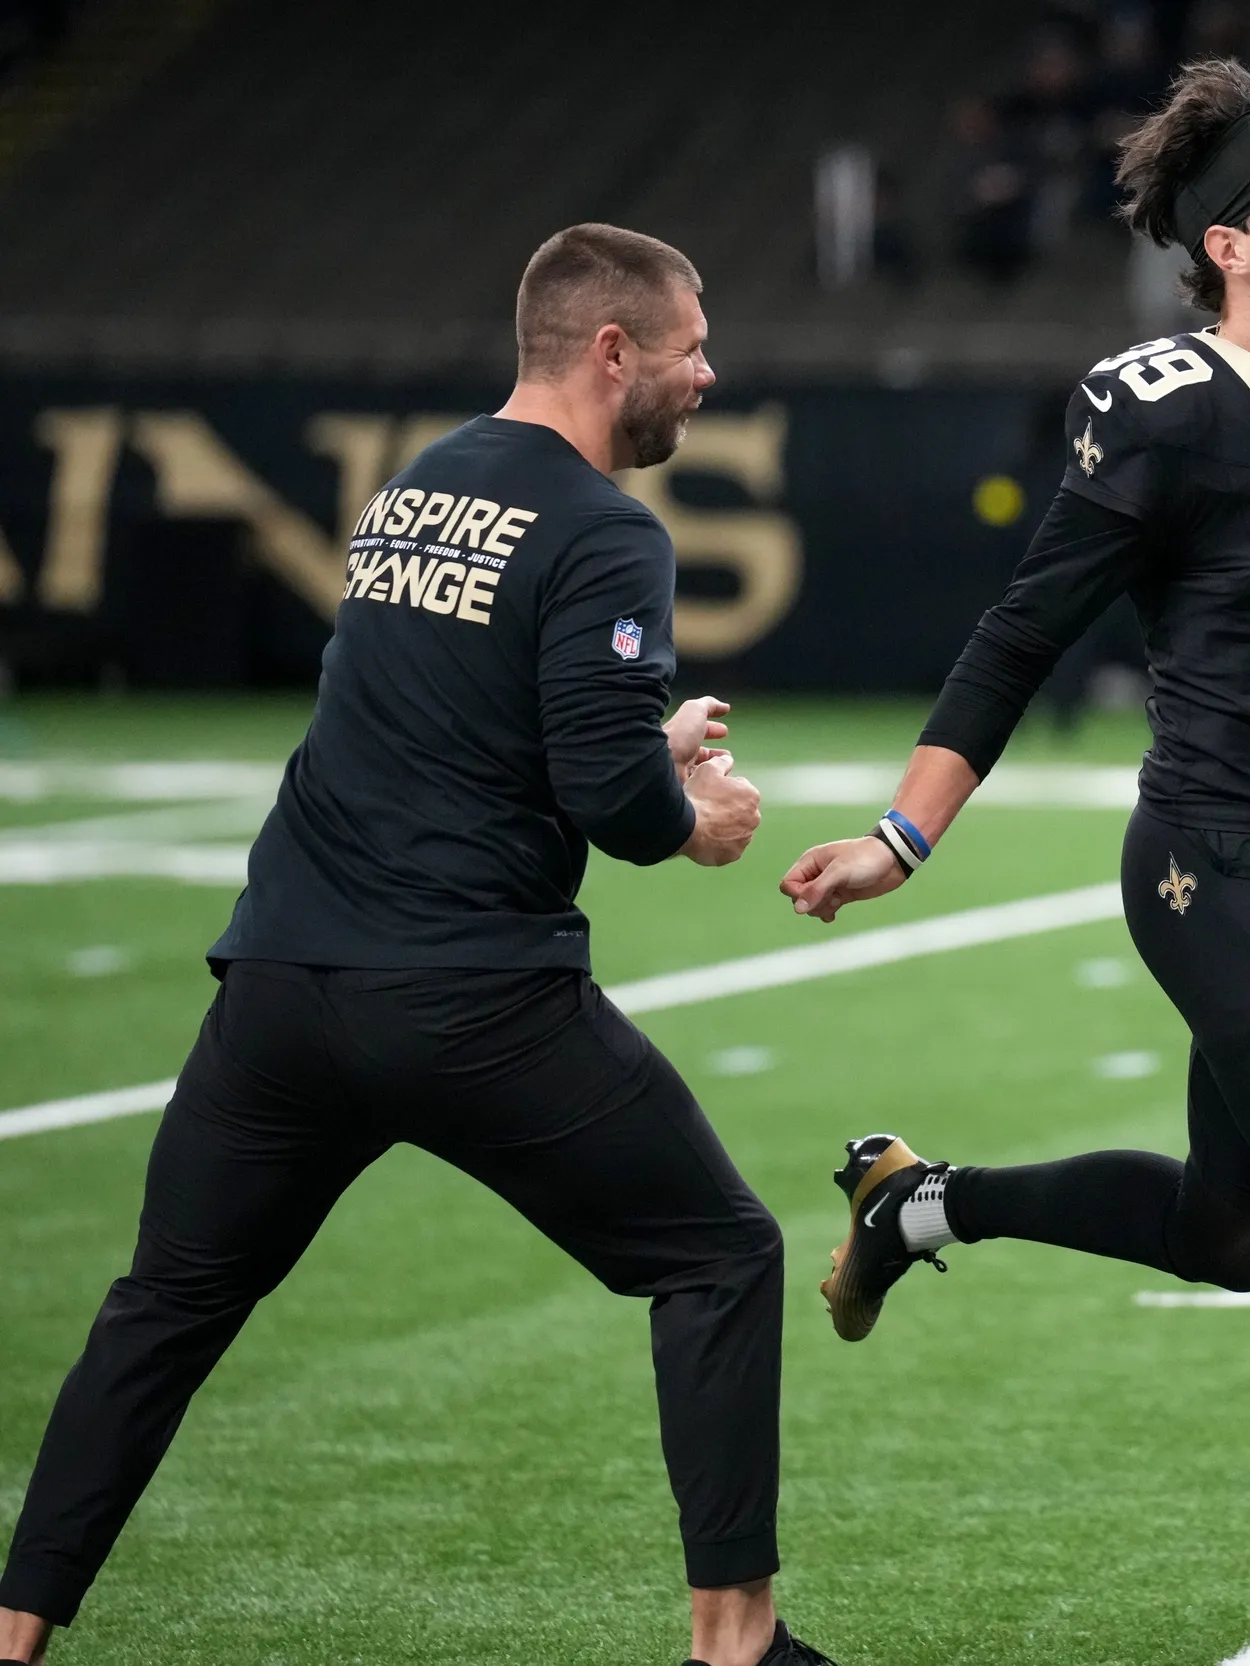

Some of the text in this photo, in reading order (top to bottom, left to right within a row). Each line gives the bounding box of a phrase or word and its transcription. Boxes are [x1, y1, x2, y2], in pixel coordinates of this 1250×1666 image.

[1088, 337, 1214, 402] 39
[0, 400, 806, 660] INS
[389, 539, 418, 551] EQUITY
[423, 544, 462, 559] FREEDOM
[467, 552, 508, 570] JUSTICE
[615, 632, 637, 655] NFL
